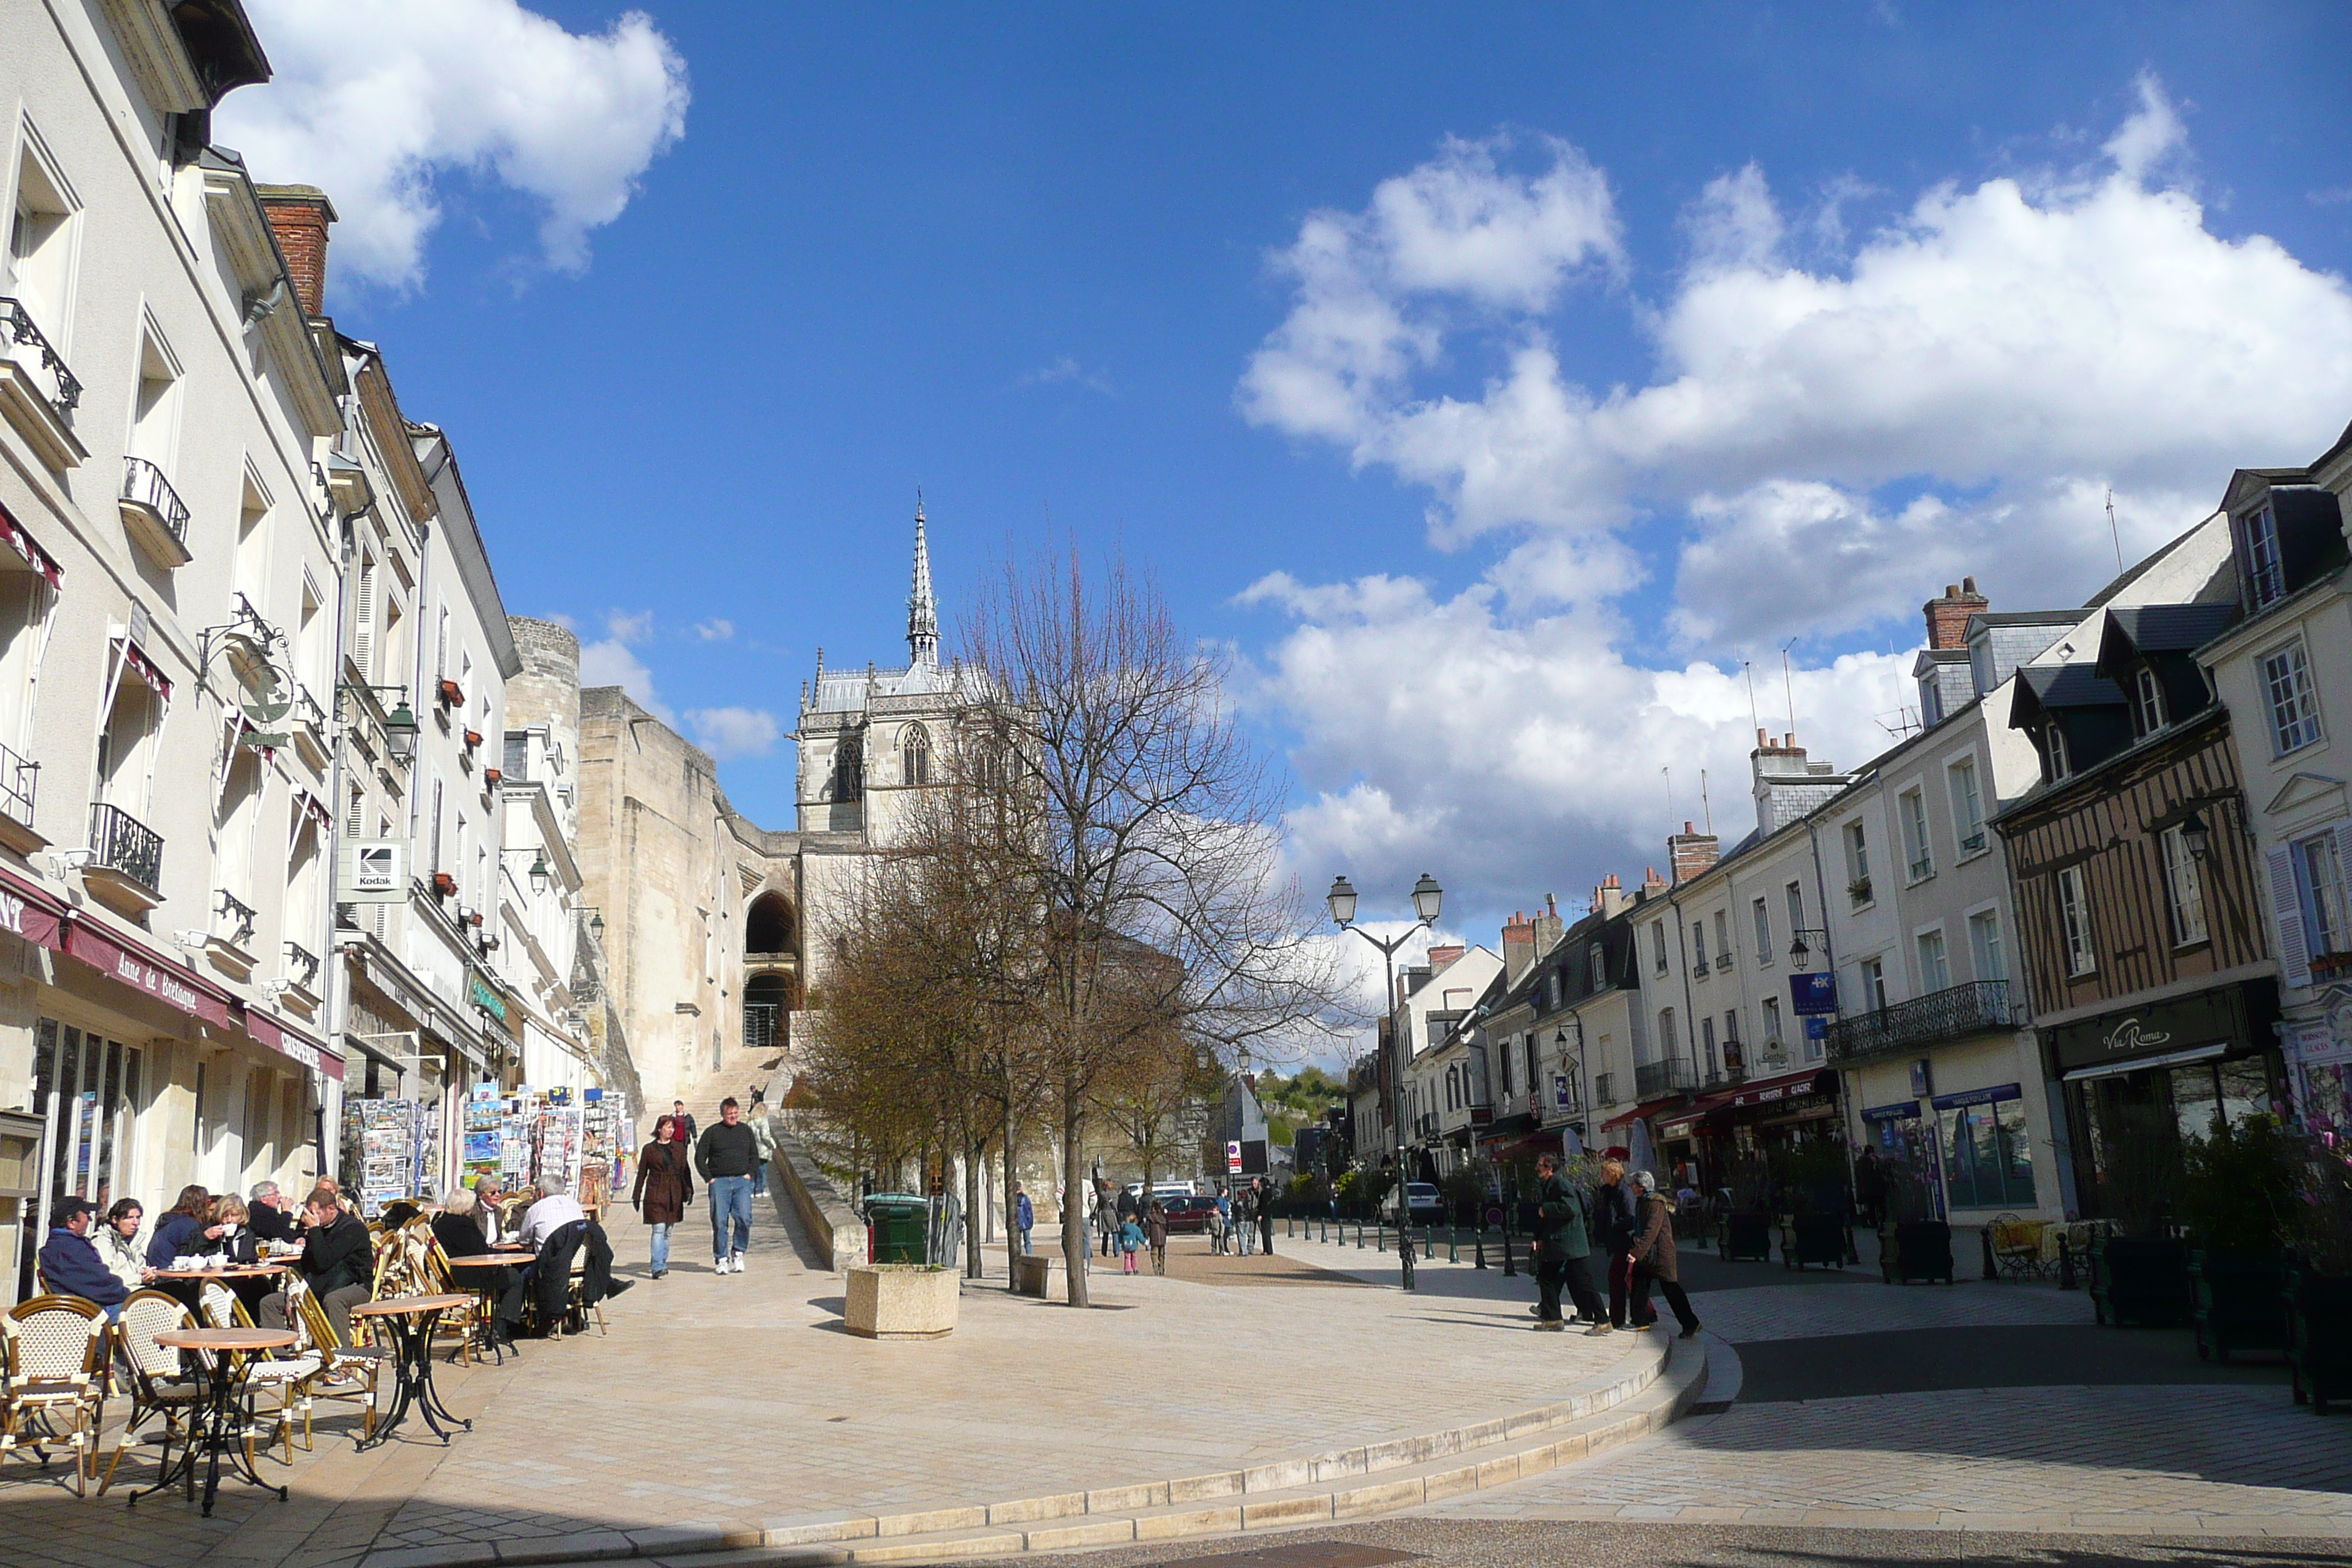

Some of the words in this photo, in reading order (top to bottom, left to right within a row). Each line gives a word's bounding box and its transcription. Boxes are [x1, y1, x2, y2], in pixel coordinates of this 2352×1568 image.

[359, 877, 391, 886] Kodak
[118, 951, 140, 983] Anne
[146, 965, 157, 990] de
[162, 973, 197, 1011] Bretagne
[2125, 1026, 2168, 1049] Roma
[1763, 1052, 1789, 1062] Gothic
